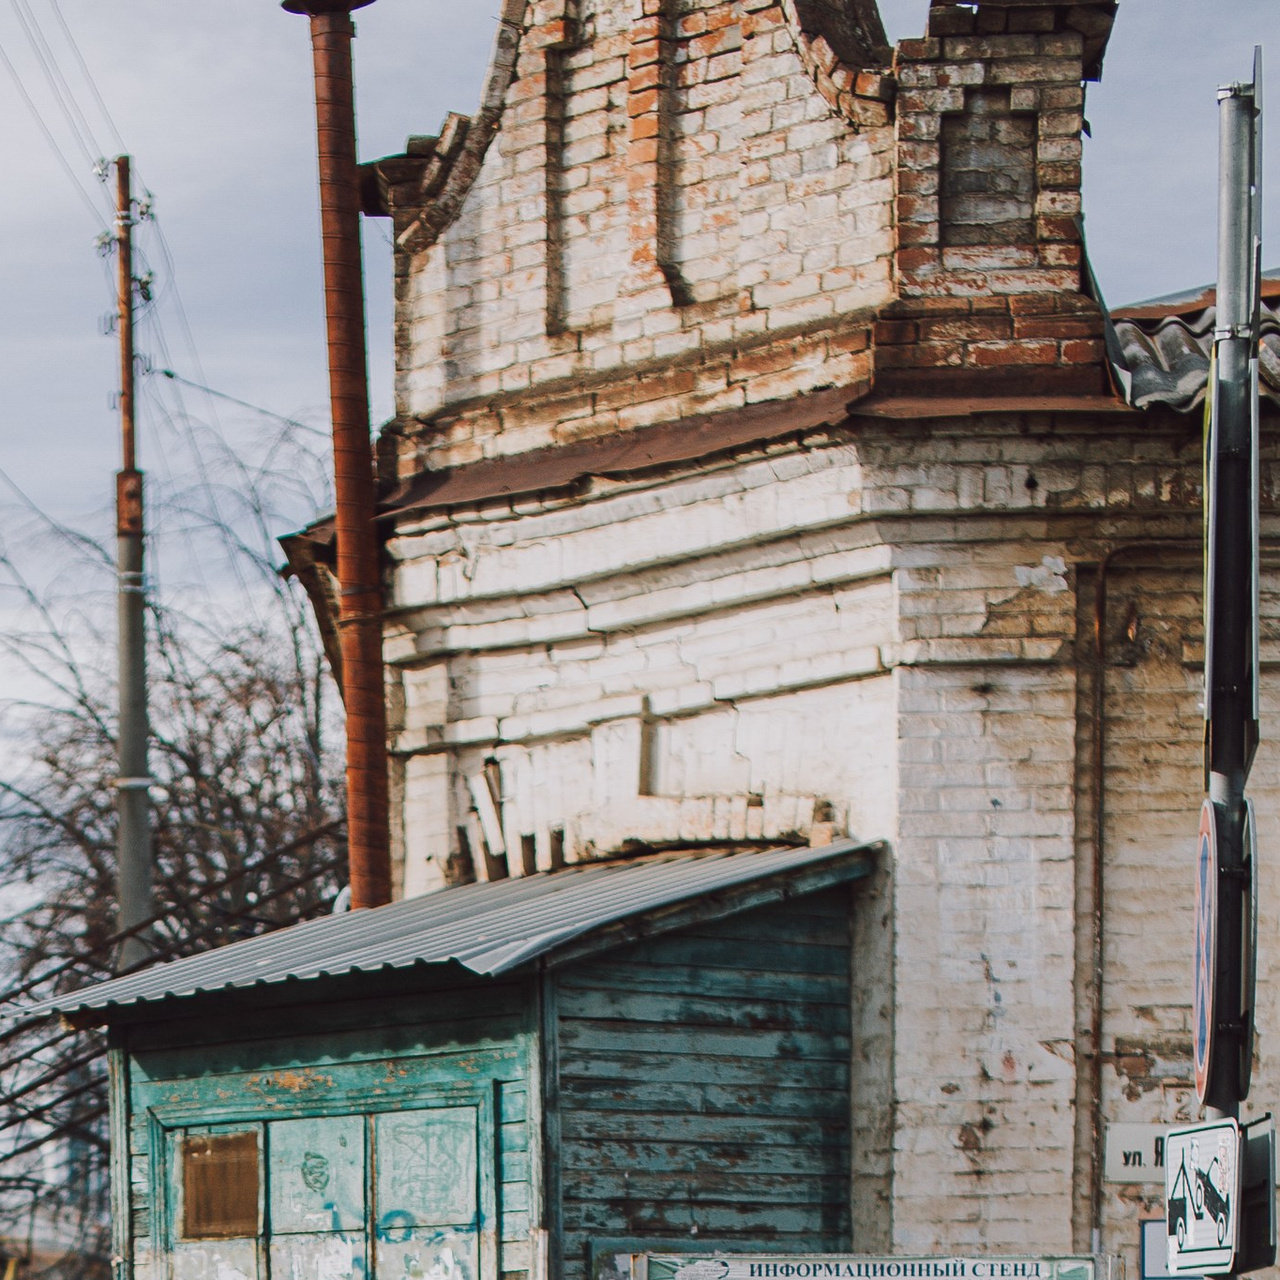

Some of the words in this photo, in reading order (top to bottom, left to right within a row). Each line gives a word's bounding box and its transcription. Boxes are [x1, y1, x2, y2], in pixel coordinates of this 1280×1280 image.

[1122, 1149, 1147, 1167] ул.
[749, 1259, 966, 1279] ИНФОРМАЦИОННЫЙ
[971, 1262, 1041, 1279] СТЕНД
